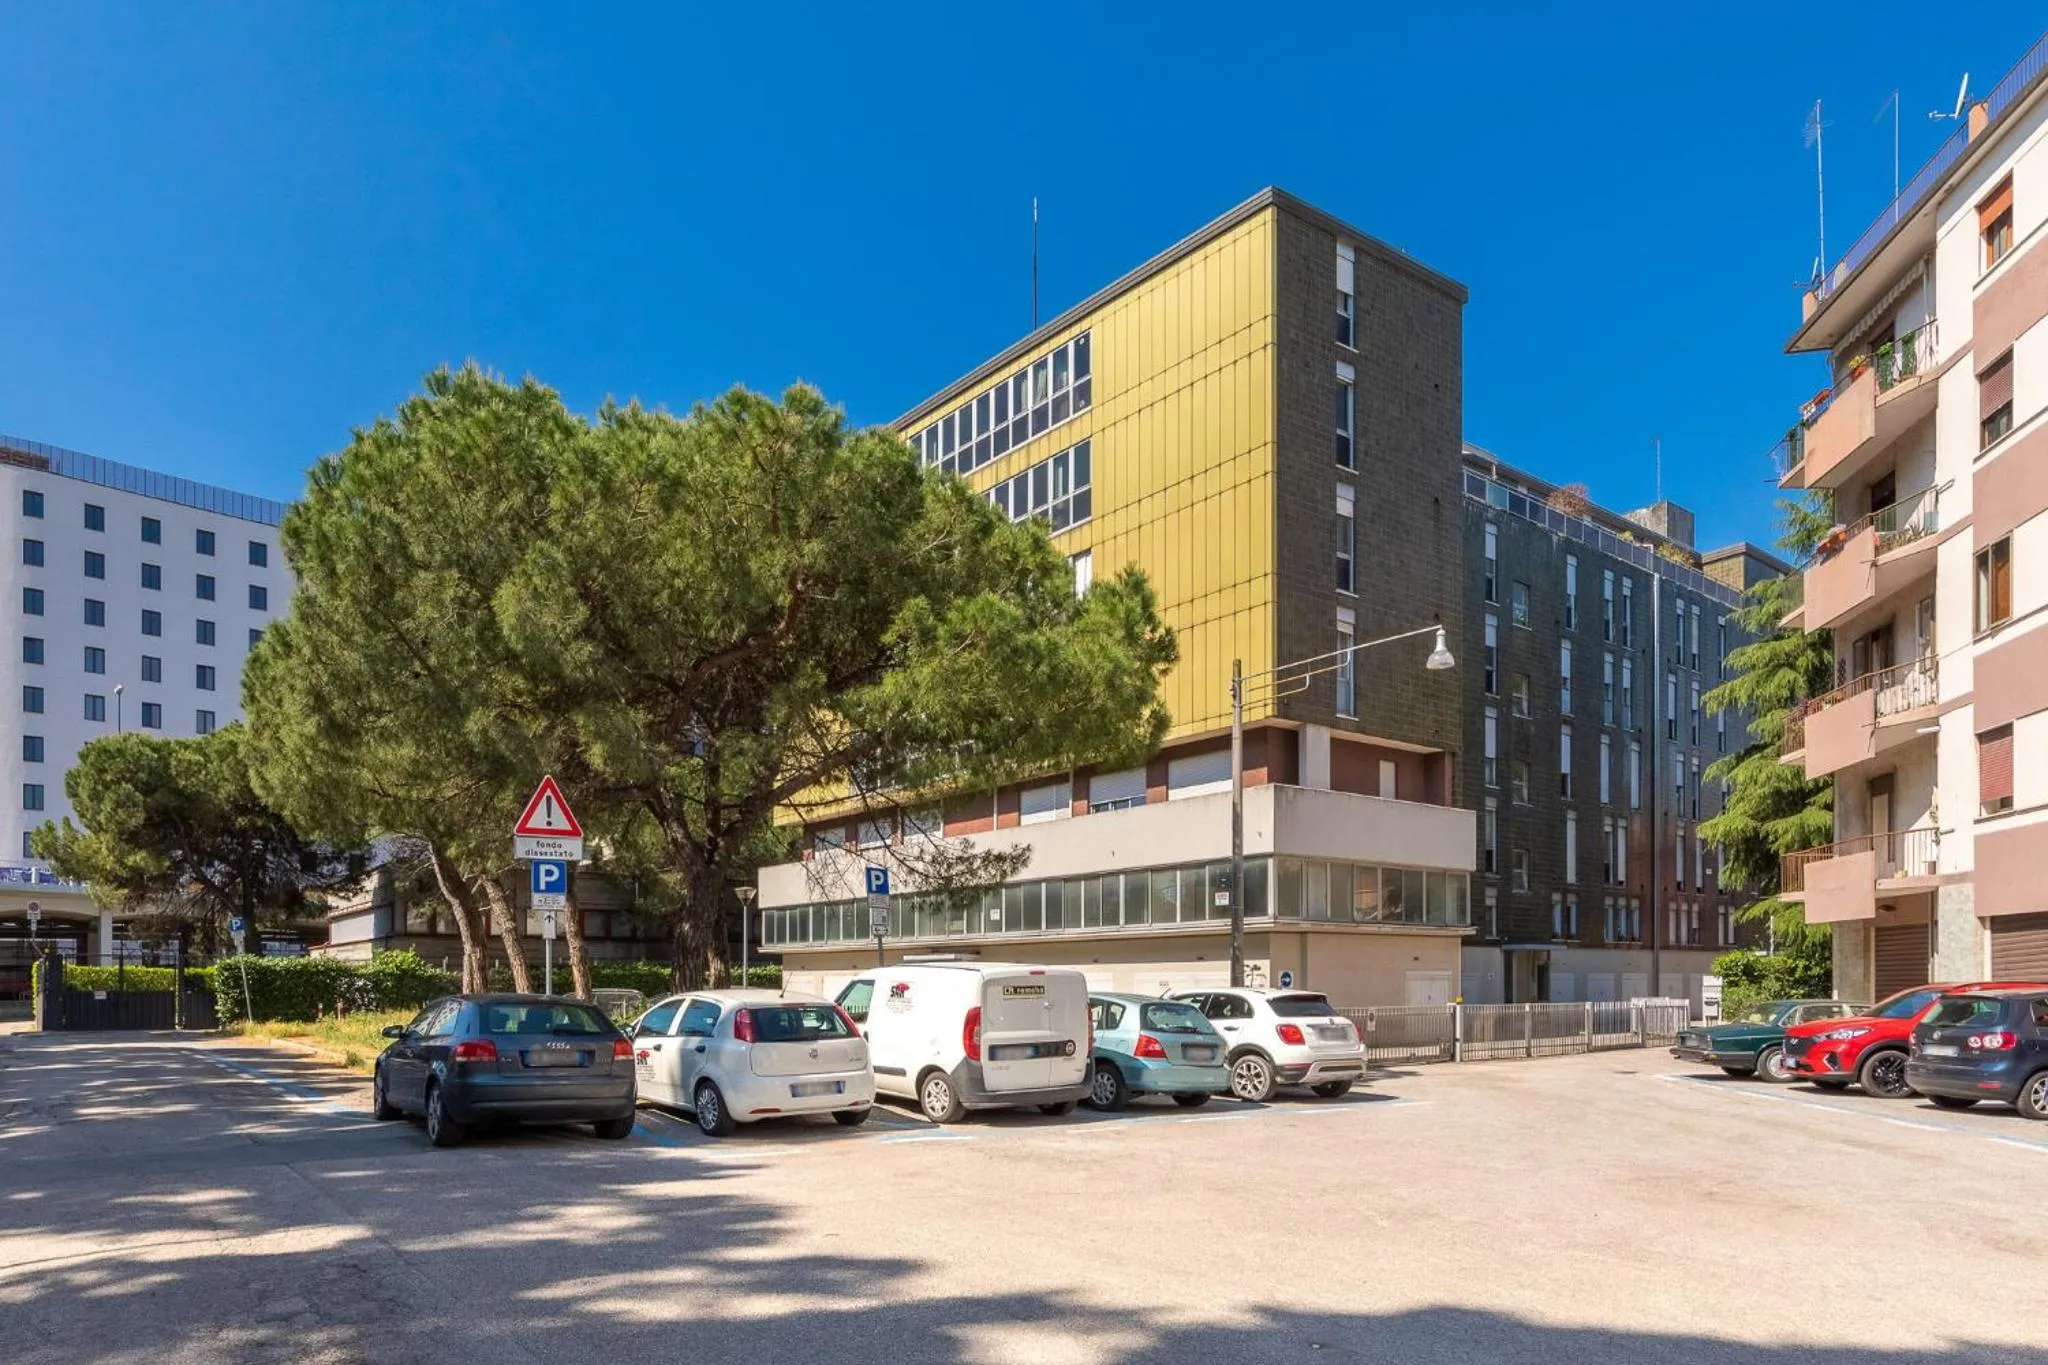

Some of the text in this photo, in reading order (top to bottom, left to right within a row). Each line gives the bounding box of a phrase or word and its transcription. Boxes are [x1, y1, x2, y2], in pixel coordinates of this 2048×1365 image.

[536, 840, 562, 849] fondo
[525, 848, 574, 857] dissestato
[539, 863, 560, 890] P
[870, 869, 885, 892] P
[231, 919, 241, 930] P
